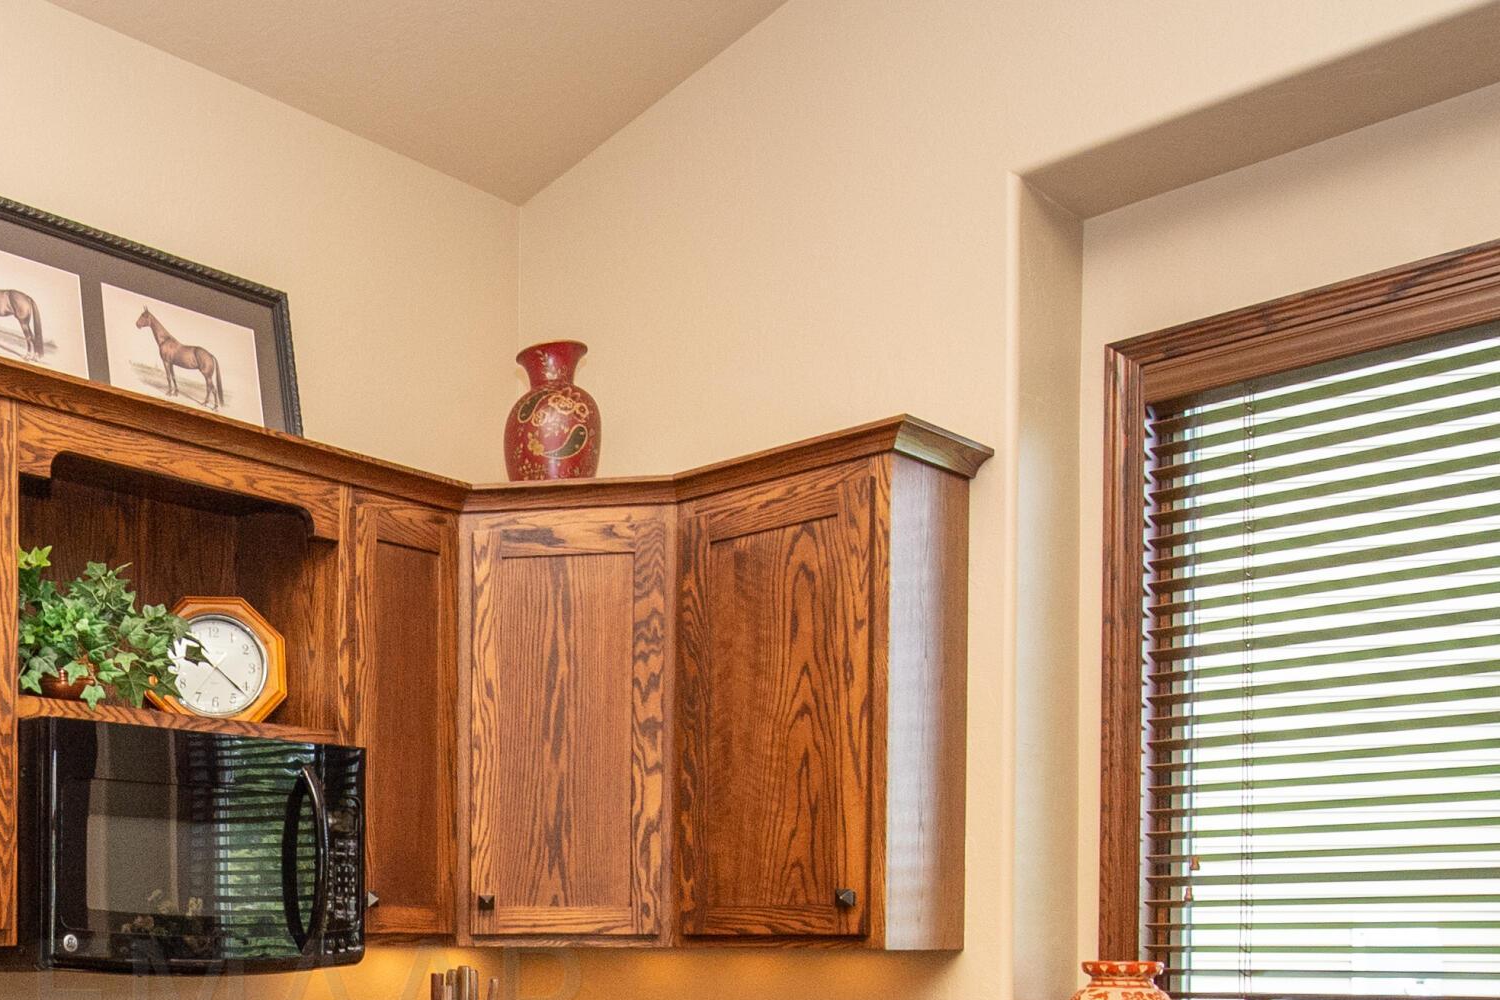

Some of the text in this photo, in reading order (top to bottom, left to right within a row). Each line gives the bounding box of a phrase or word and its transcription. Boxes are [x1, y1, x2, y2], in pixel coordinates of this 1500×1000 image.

[208, 626, 220, 638] 12
[242, 644, 250, 655] 2
[248, 663, 256, 674] 3
[242, 680, 250, 691] 4
[195, 691, 202, 703] 7
[212, 696, 219, 707] 6
[229, 693, 237, 704] 5
